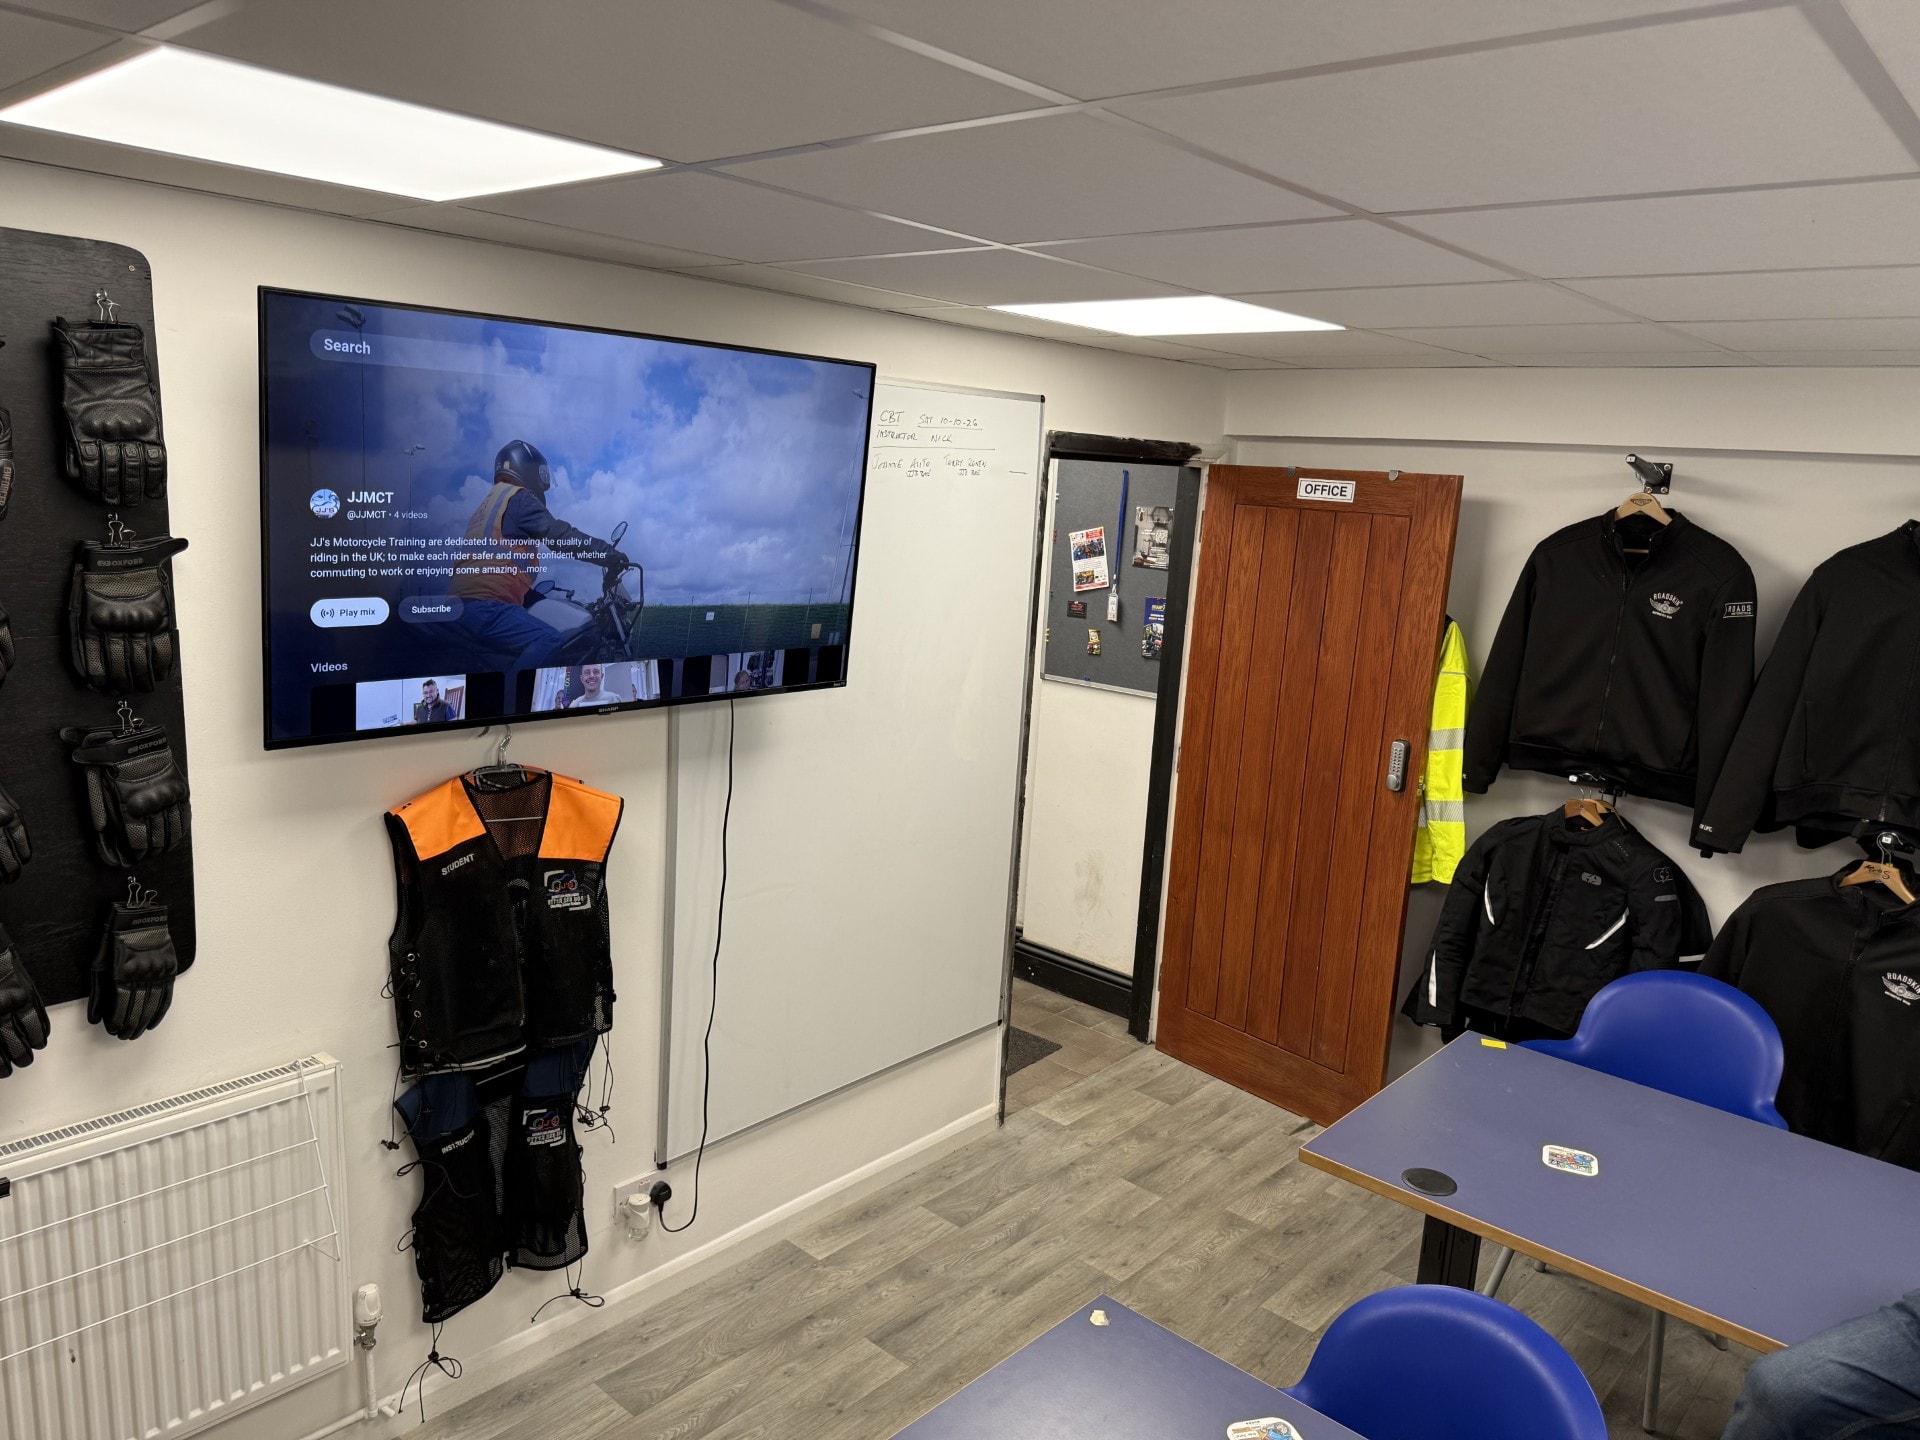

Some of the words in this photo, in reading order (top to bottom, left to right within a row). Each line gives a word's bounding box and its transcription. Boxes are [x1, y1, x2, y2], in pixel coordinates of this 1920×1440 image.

[323, 338, 371, 355] Search
[879, 409, 905, 424] CBT
[1304, 483, 1348, 497] OFFICE
[346, 491, 395, 504] JJMCT
[346, 510, 387, 520] @JJMCT
[393, 511, 400, 519] 4
[401, 510, 428, 519] videos
[310, 537, 331, 547] JJ's
[333, 537, 387, 549] Motorcycle
[388, 537, 426, 549] Training
[444, 537, 487, 546] dedicated
[489, 537, 498, 546] to
[499, 537, 541, 549] improving
[542, 537, 555, 546] the
[556, 537, 582, 549] quality
[583, 537, 592, 546] of
[111, 557, 144, 566] OXFORD
[310, 553, 338, 564] riding
[340, 553, 350, 562] in
[352, 552, 367, 562] the
[369, 552, 386, 563] UK;
[387, 553, 397, 561] to
[399, 552, 425, 561] make
[426, 551, 448, 561] each
[450, 551, 470, 560] rider
[472, 551, 494, 560] safer
[495, 551, 511, 560] and
[513, 552, 535, 560] more
[536, 551, 575, 560] confident,
[576, 550, 607, 559] whether
[310, 568, 366, 579] commuting
[368, 568, 378, 576] to
[380, 567, 403, 576] work
[405, 568, 415, 576] or
[416, 566, 454, 577] enjoying
[455, 566, 480, 575] some
[481, 566, 518, 575] amazing
[339, 609, 358, 618] Play
[360, 608, 376, 616] mix
[411, 604, 452, 614] Subscribe
[310, 662, 348, 673] Videos
[441, 853, 475, 876] STUDENT
